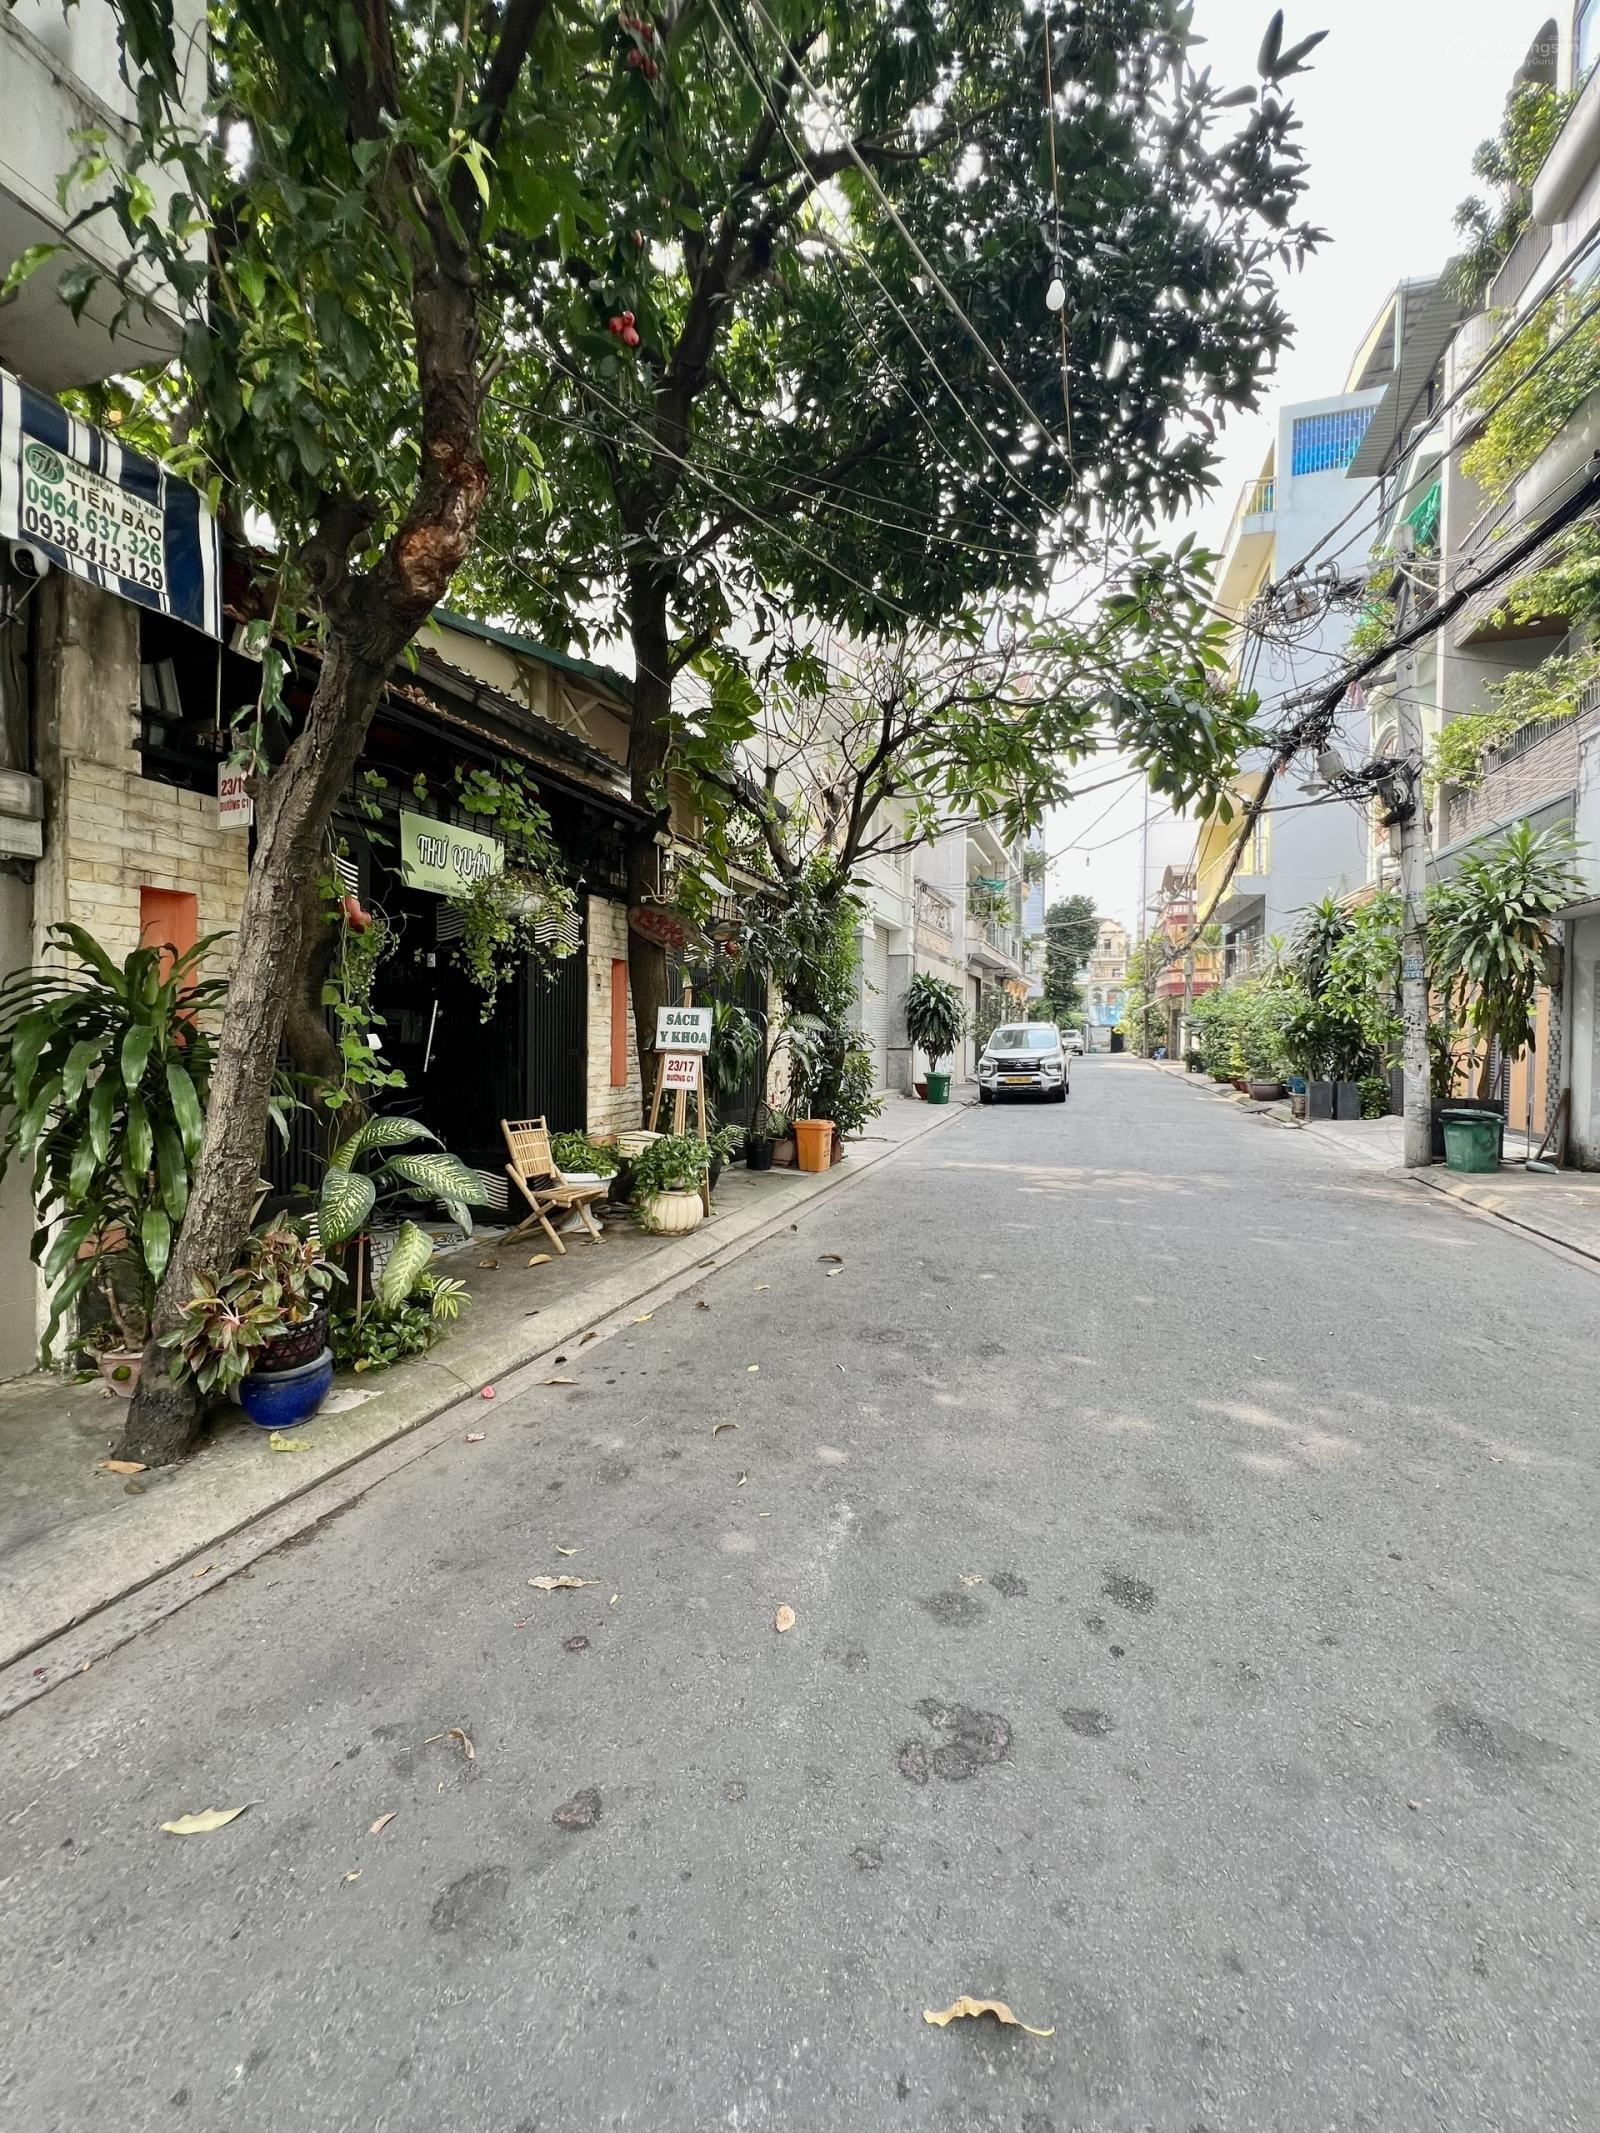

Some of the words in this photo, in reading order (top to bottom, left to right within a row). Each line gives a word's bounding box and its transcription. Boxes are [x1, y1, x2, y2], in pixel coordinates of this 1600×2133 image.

[26, 478, 161, 566] 0964.637.326
[66, 479, 115, 517] TIẾN
[122, 508, 161, 541] BẢO
[25, 506, 163, 590] 0938.413.129
[220, 776, 243, 796] 23/1
[417, 834, 449, 869] THƯ
[452, 844, 491, 879] QUÁN
[666, 1011, 699, 1026] SÁCH
[660, 1031, 668, 1042] Y
[671, 1031, 708, 1043] KHOA
[667, 1060, 695, 1072] 23/17
